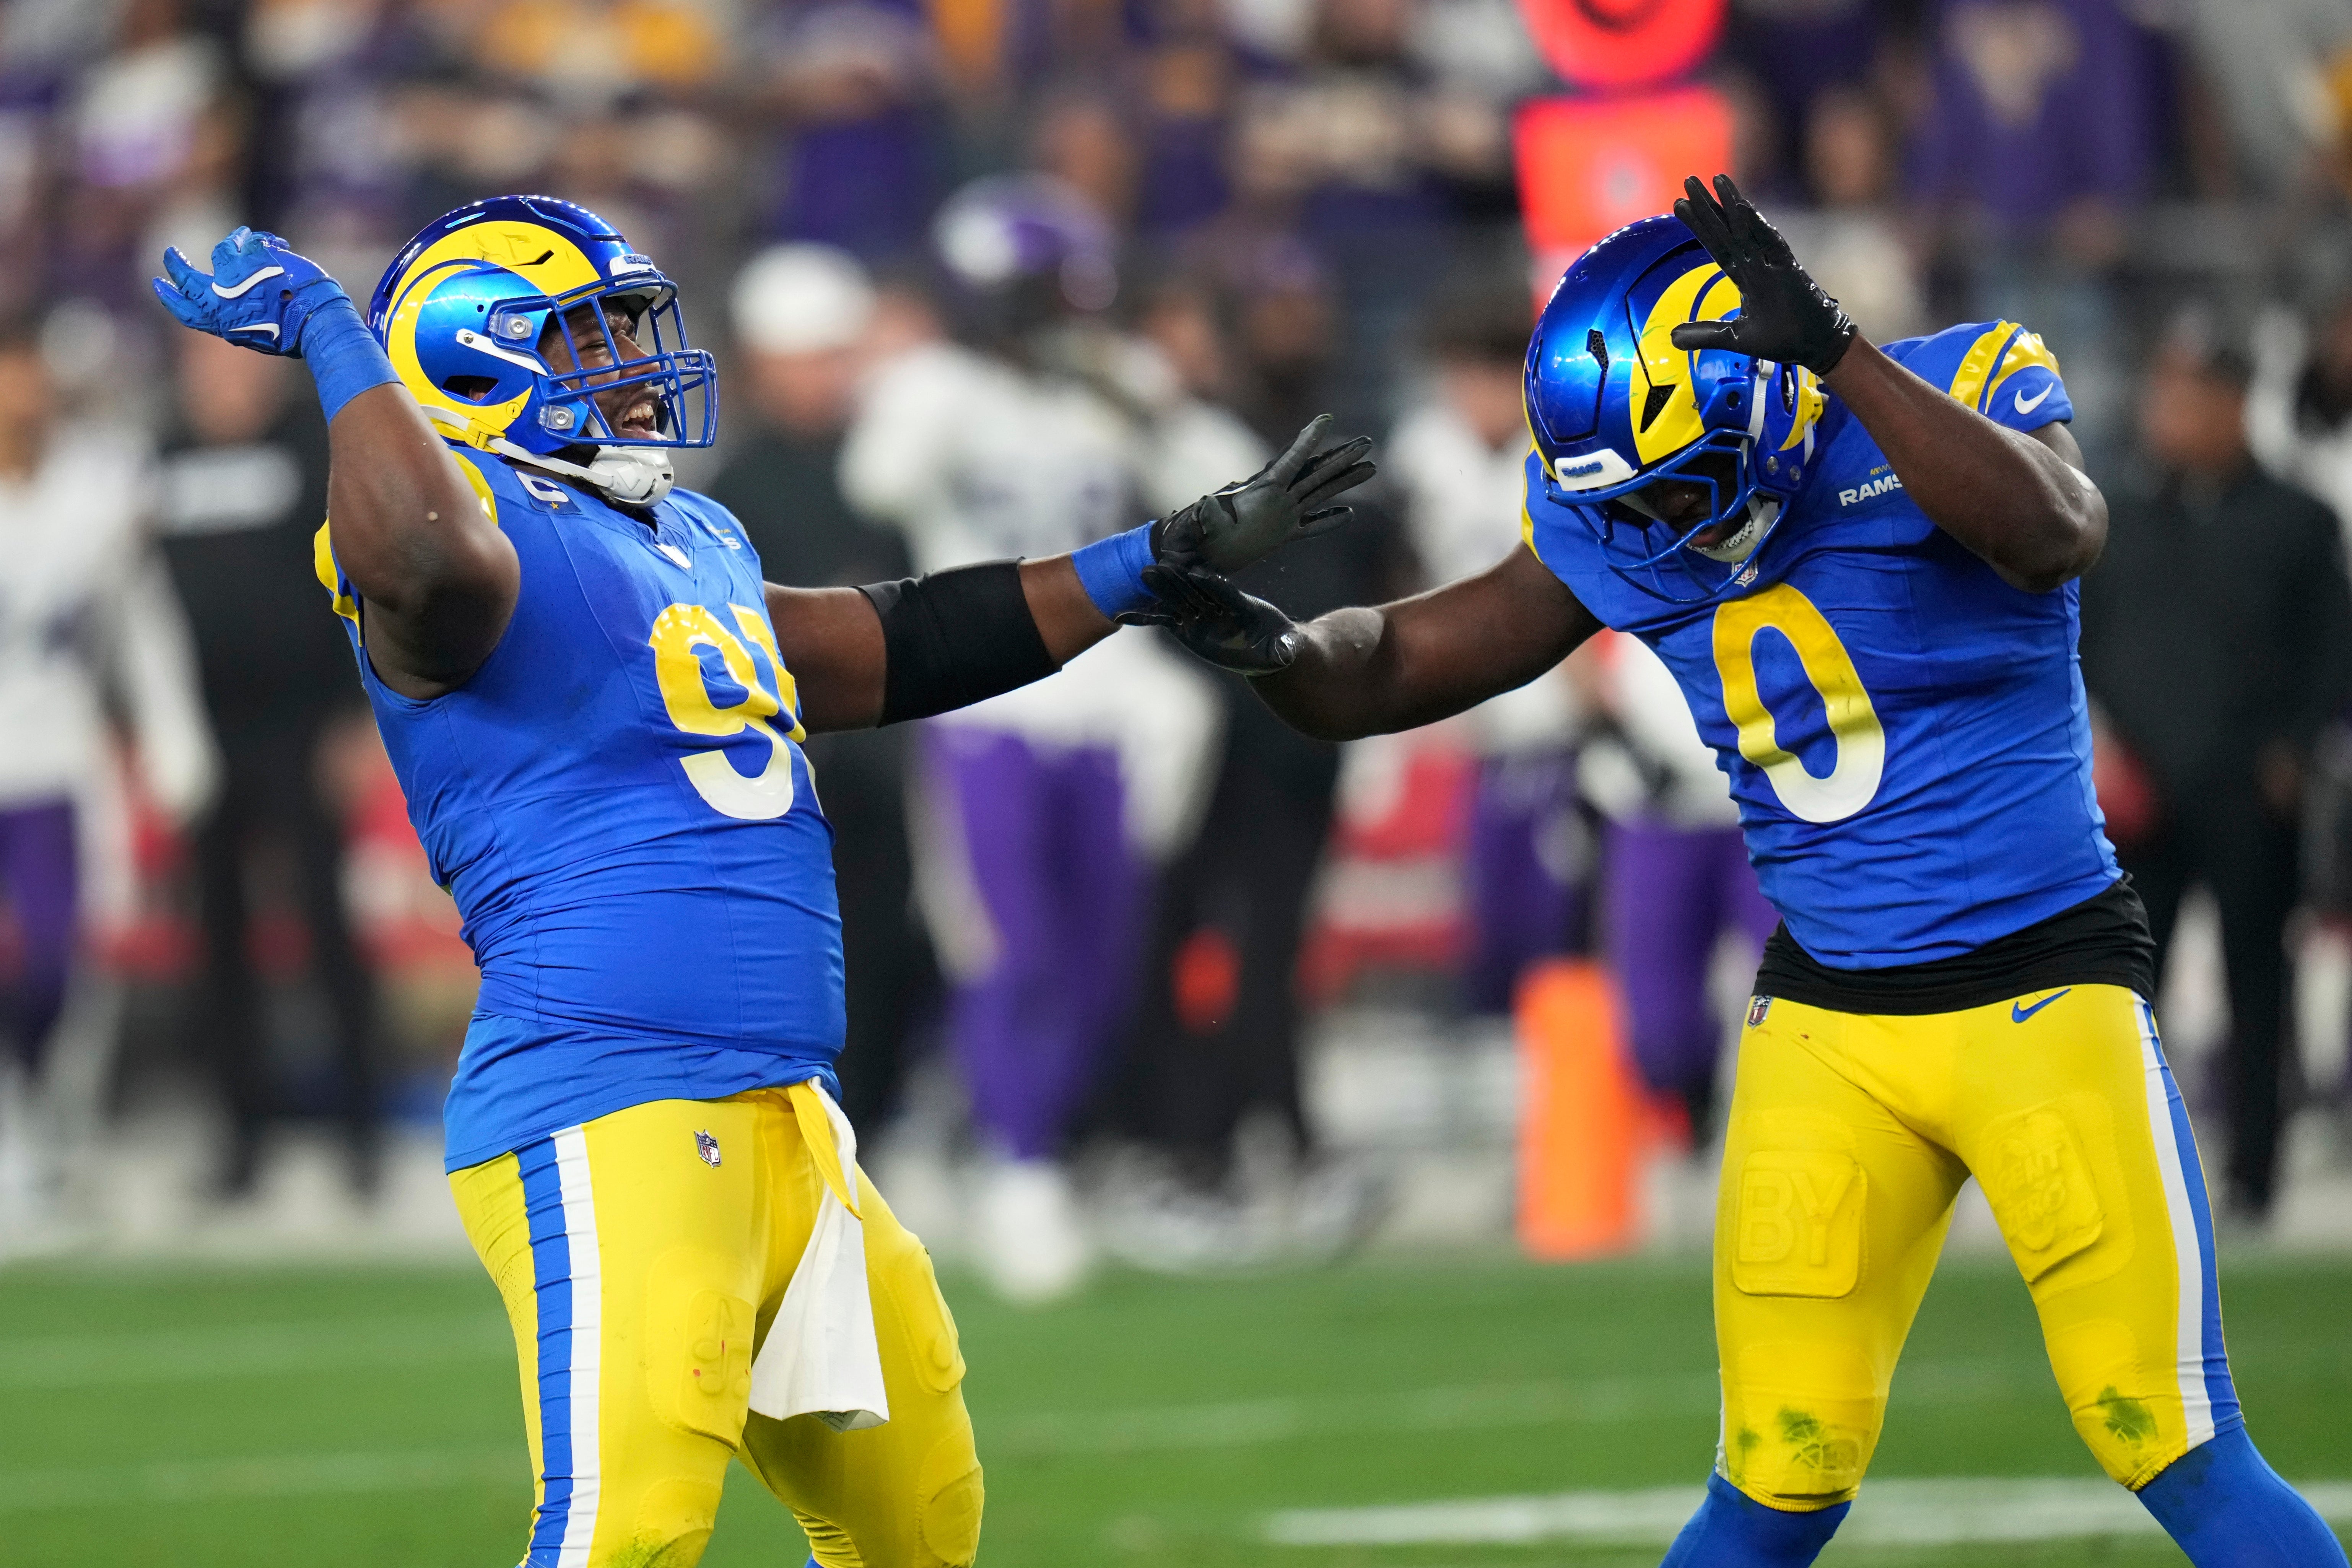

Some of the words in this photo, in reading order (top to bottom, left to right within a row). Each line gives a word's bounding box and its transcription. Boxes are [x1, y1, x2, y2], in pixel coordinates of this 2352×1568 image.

[623, 255, 652, 265] RAMS
[515, 471, 569, 502] C
[1712, 582, 1886, 823] 0
